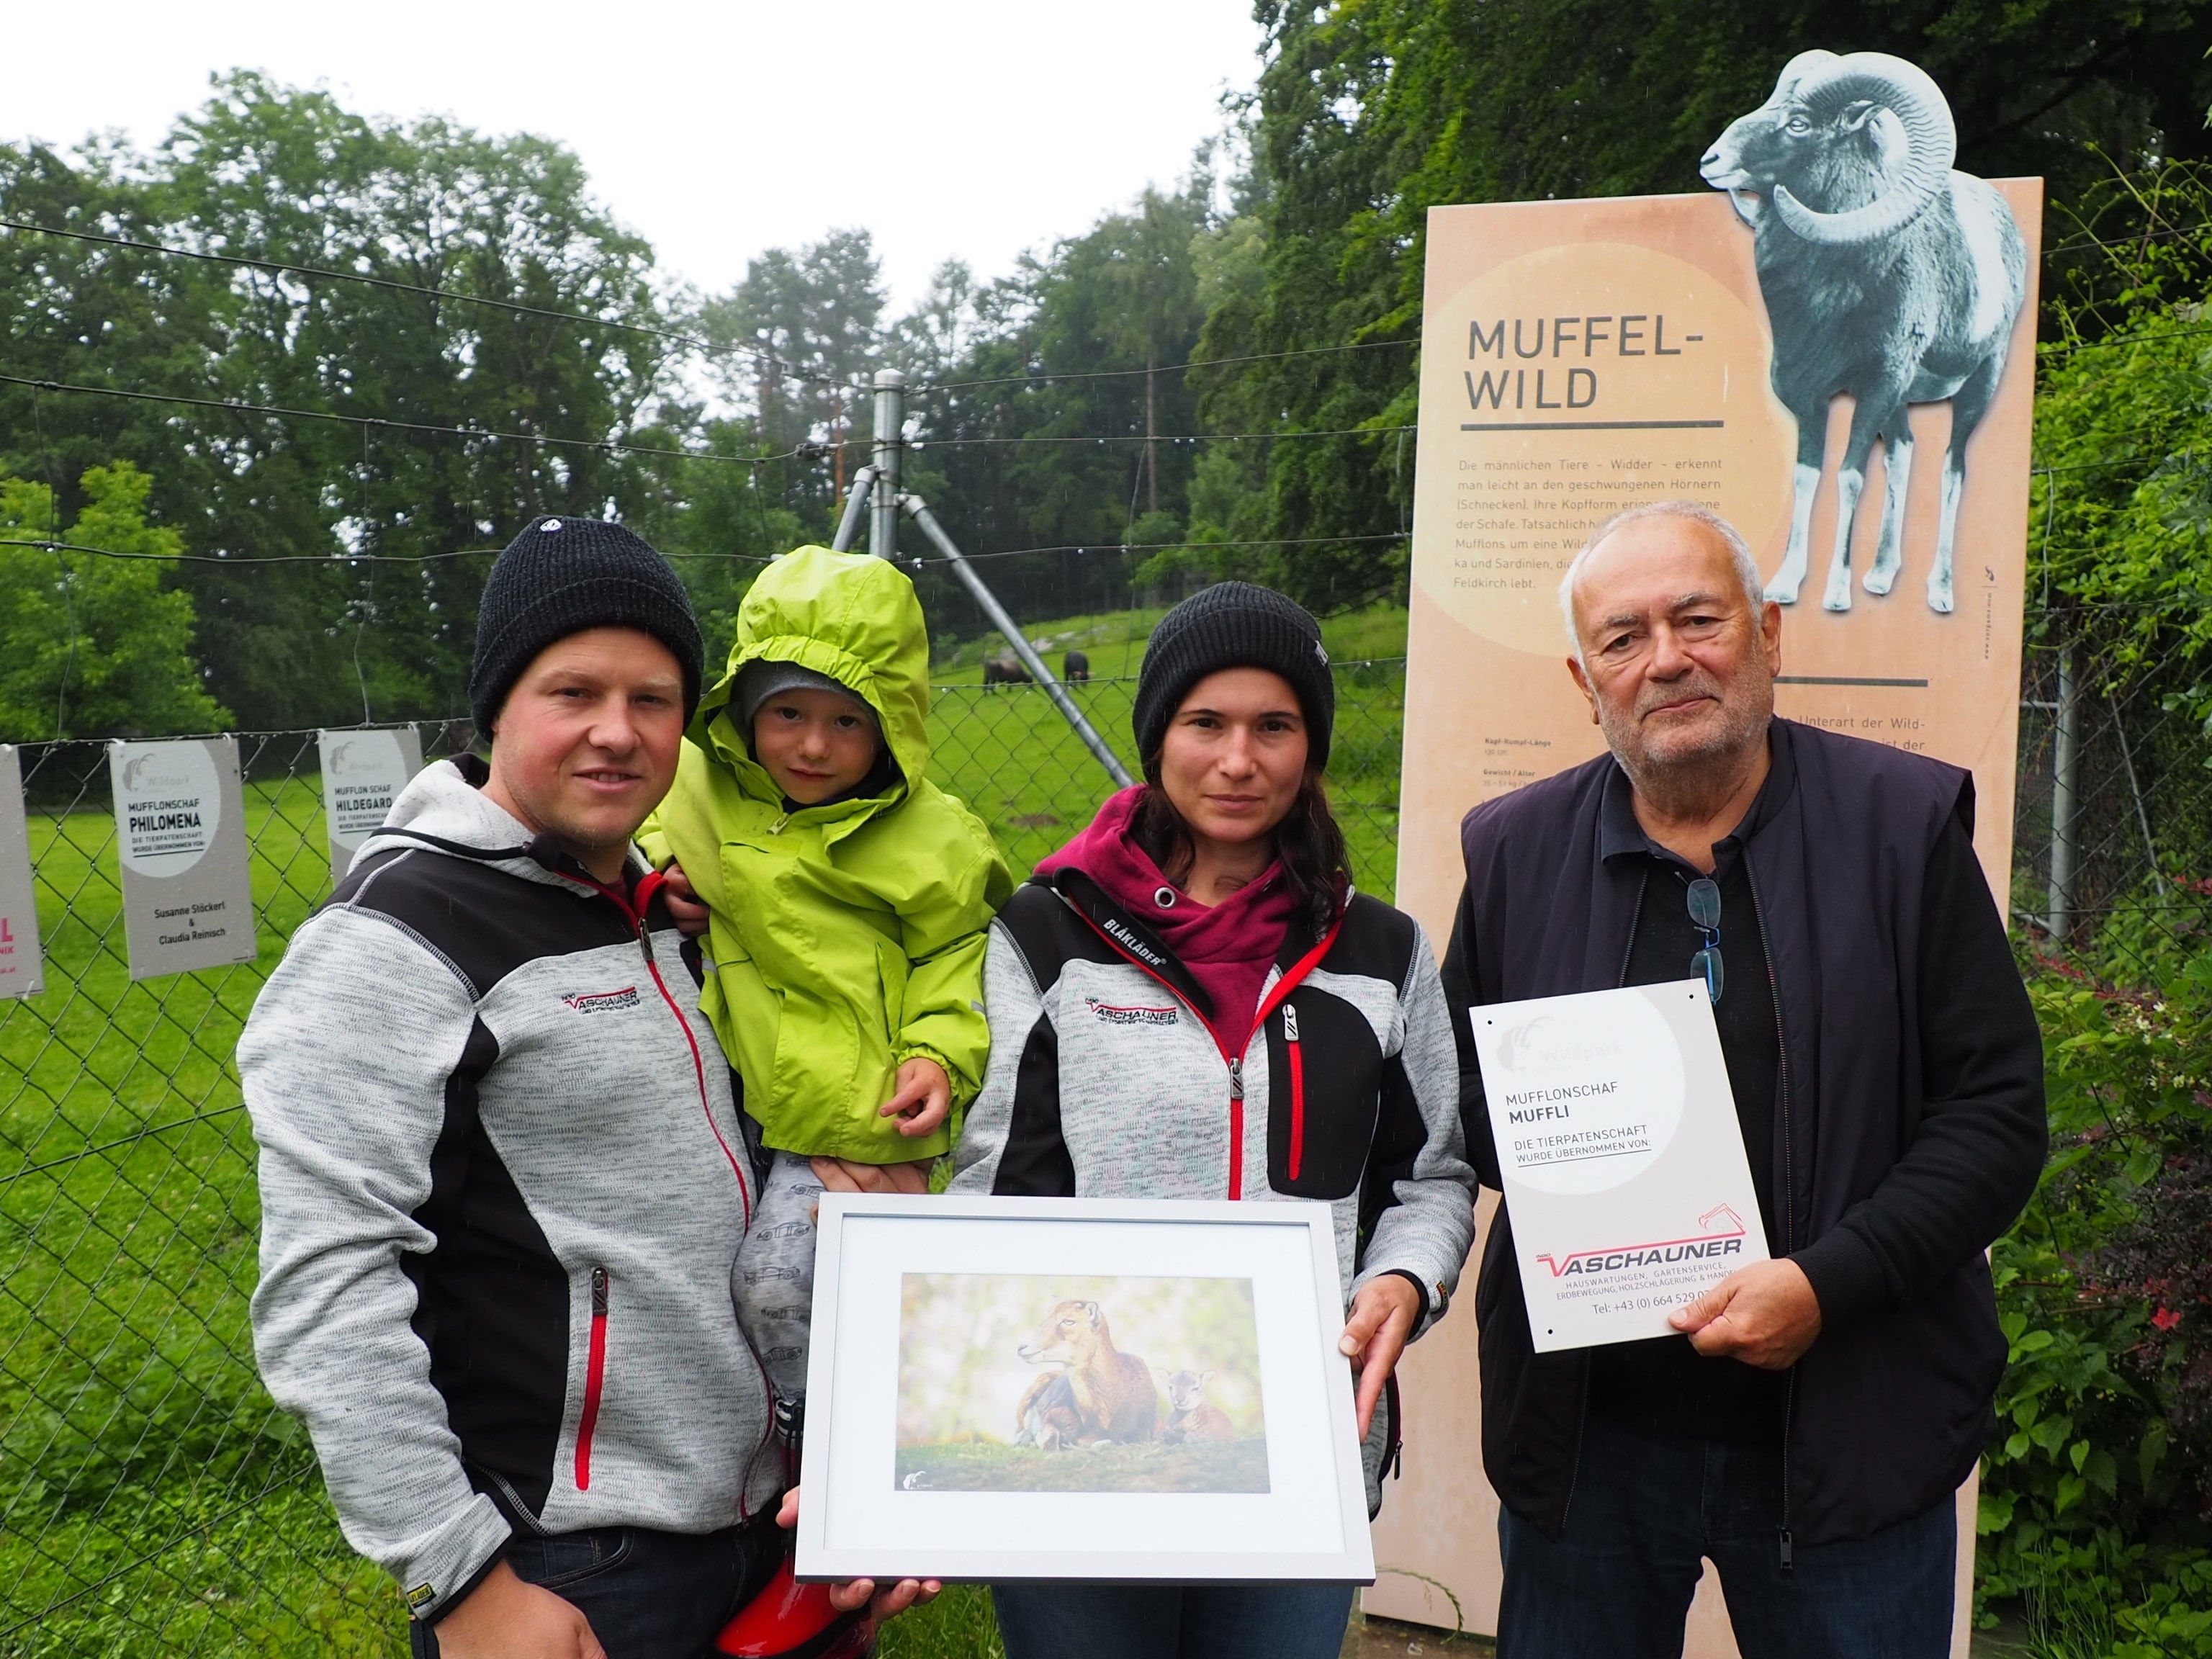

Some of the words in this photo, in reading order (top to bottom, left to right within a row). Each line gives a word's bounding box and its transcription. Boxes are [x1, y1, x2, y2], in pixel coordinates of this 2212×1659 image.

[1468, 315, 1703, 359] MUFFEL-
[1464, 368, 1597, 409] WILD
[1459, 460, 1477, 470] Die
[1484, 459, 1551, 470] männlichen
[1560, 459, 1588, 469] Tiere
[1611, 459, 1653, 469] Widder
[1676, 459, 1722, 469] erkennt
[1488, 480, 1519, 490] leicht
[1543, 480, 1563, 490] den
[1569, 480, 1664, 492] geschwungenen
[1671, 479, 1721, 490] Hörnern
[1534, 499, 1557, 509] Ihre
[1562, 499, 1617, 511] Kopfform
[1456, 519, 1474, 529] der
[1478, 519, 1519, 529] Schafe.
[1521, 518, 1586, 529] Tatsächlich
[1456, 539, 1505, 549] Mufflons
[1534, 540, 1557, 549] eine
[1455, 557, 1467, 569] ka
[1471, 558, 1491, 568] und
[1496, 557, 1552, 570] Sardinien,
[1454, 577, 1506, 588] Feldkirch
[1511, 578, 1536, 588] lebt.
[1800, 715, 1854, 727] Unterart
[1862, 719, 1884, 728] der
[1890, 718, 1925, 729] Wild-
[1485, 738, 1551, 747] Kopf-Rumpf-Länge
[1903, 739, 1925, 750] der
[334, 786, 367, 796] MUFFLON
[369, 784, 391, 793] SCHAF
[128, 799, 199, 812] MUFFLONSCHAF
[336, 797, 392, 811] HILDEGARD
[130, 812, 201, 832] PHILOMENA
[145, 832, 202, 842] TIERPATENSCHAFT
[154, 907, 189, 918] Susanne
[189, 918, 194, 927] &
[159, 932, 190, 945] Claudia
[1506, 1082, 1617, 1106] MUFFLONSCHAF
[1509, 1105, 1569, 1124] MUFFLI
[1514, 1139, 1534, 1151] DIE
[1537, 1125, 1647, 1146] TIERPATENSCHAFT
[1516, 1151, 1552, 1162] WURDE
[1556, 1141, 1625, 1158] ÜBERNOMMEN
[1628, 1138, 1651, 1148] VON:
[1537, 1238, 1741, 1277] VASCHAUNER
[1566, 1272, 1647, 1289] HAUSWARTUNGEN,
[1653, 1262, 1726, 1277] GARTENSERVICE,
[1557, 1285, 1618, 1300] ERDBEWEGUNG,
[1593, 1303, 1611, 1314] Tel:
[1614, 1300, 1634, 1310] +43
[1637, 1298, 1650, 1309] (0)
[1653, 1295, 1672, 1306] 664
[1676, 1292, 1695, 1303] 529
